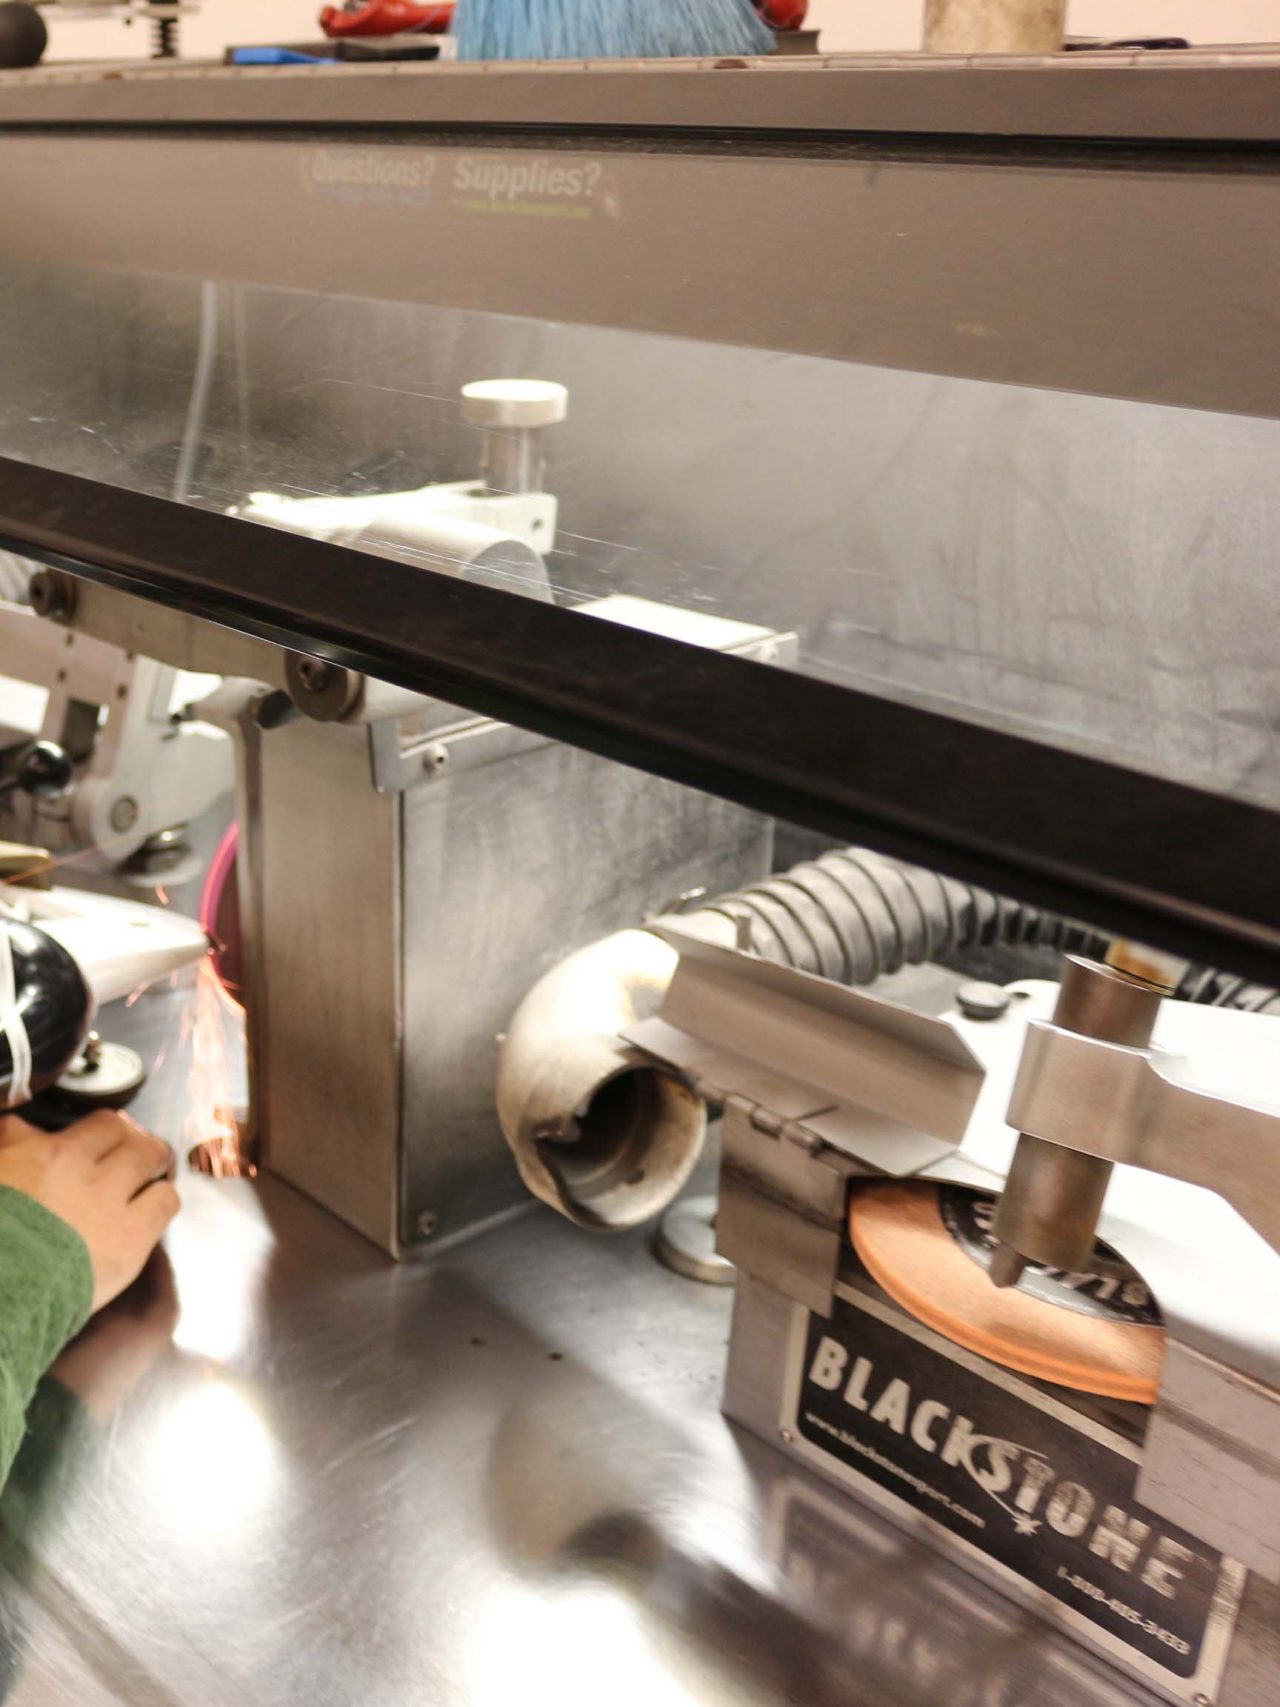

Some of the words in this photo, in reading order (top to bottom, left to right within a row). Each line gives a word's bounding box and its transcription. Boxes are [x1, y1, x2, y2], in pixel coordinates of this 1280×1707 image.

[312, 151, 437, 187] Questions?
[452, 157, 602, 199] Supplies?
[808, 1336, 1195, 1599] BLACKSTONE
